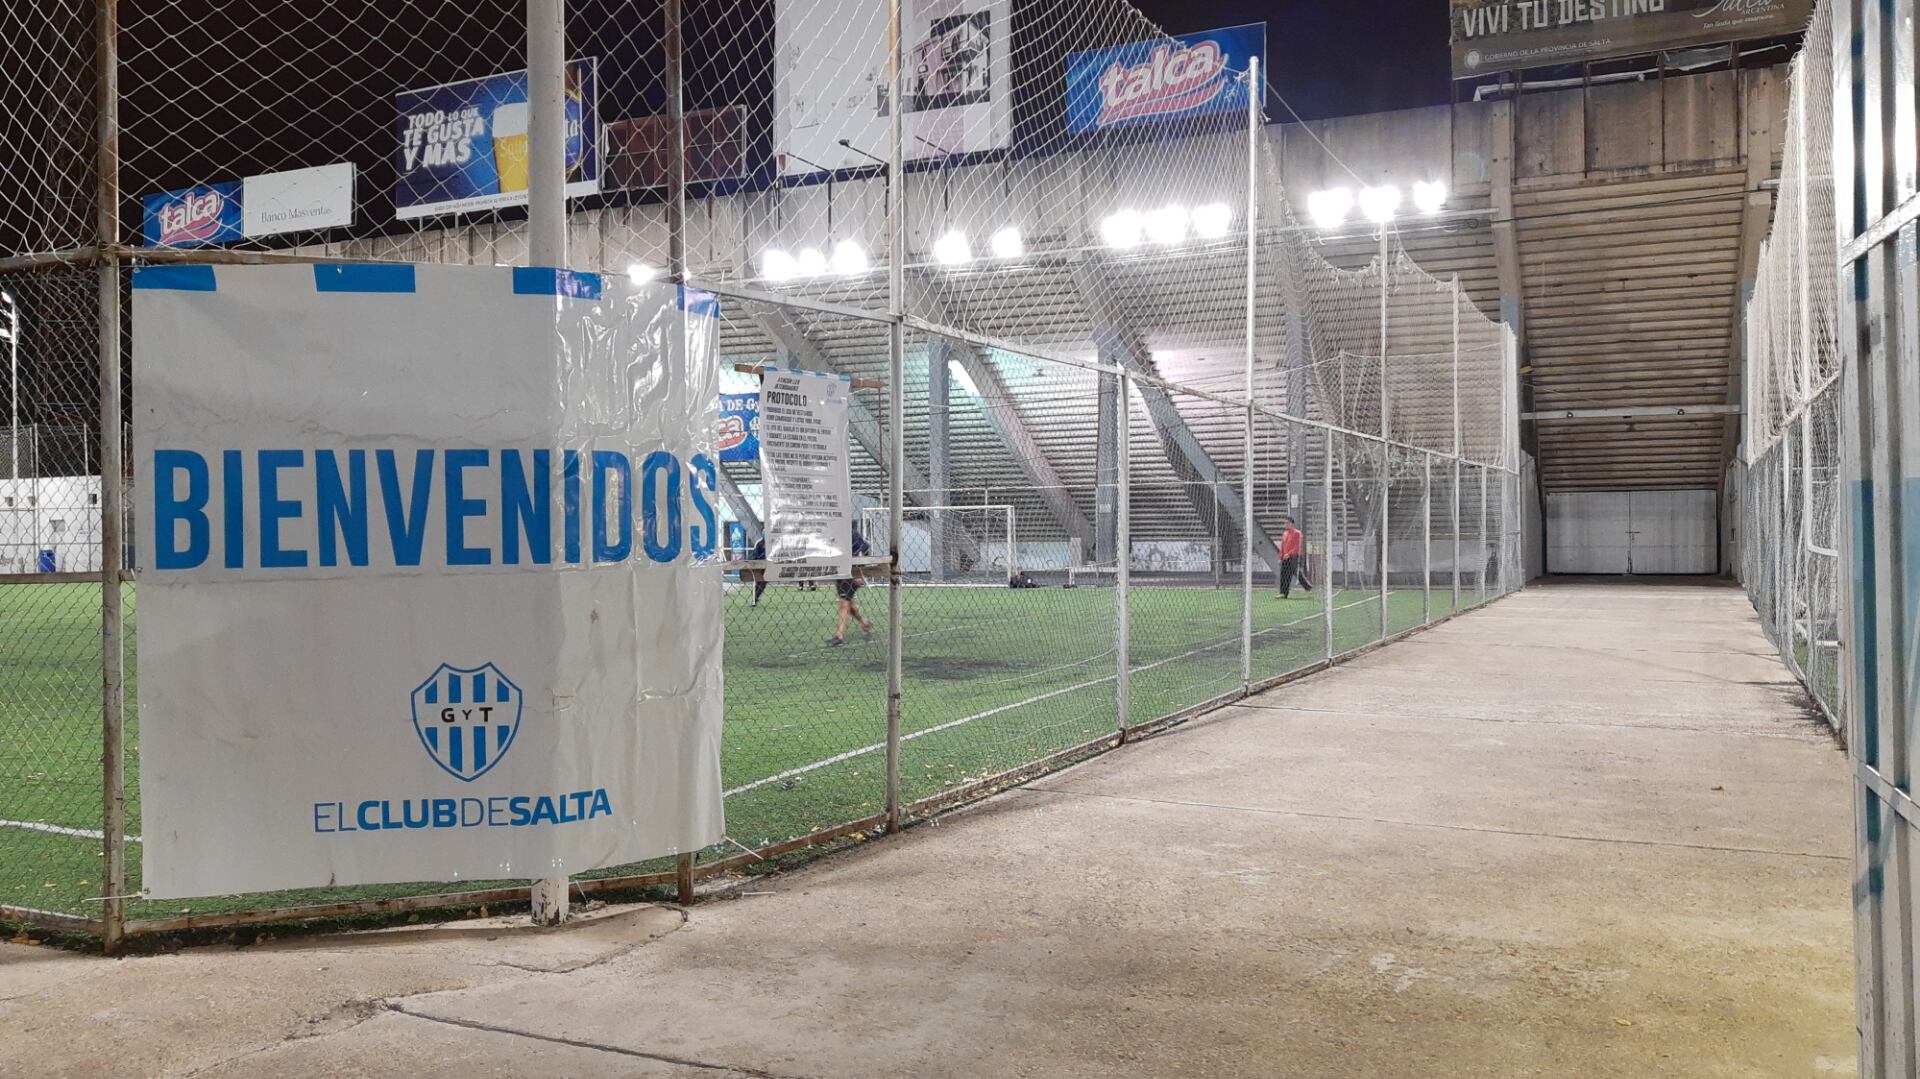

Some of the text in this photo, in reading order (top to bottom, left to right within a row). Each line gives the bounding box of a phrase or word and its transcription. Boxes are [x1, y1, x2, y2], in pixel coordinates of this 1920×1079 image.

[1517, 0, 1548, 31] TU
[1520, 49, 1529, 57] DE
[1540, 43, 1577, 54] PROVINCIA
[1101, 42, 1218, 107] talca
[408, 107, 479, 129] TODO LO QUE
[403, 116, 484, 148] TE GUSTA
[404, 147, 418, 170] Y
[160, 193, 219, 232] talca
[261, 210, 287, 223] Banco
[727, 399, 743, 411] DE
[767, 390, 807, 407] PROTOCOLO
[154, 448, 717, 570] BIENVENIDOS
